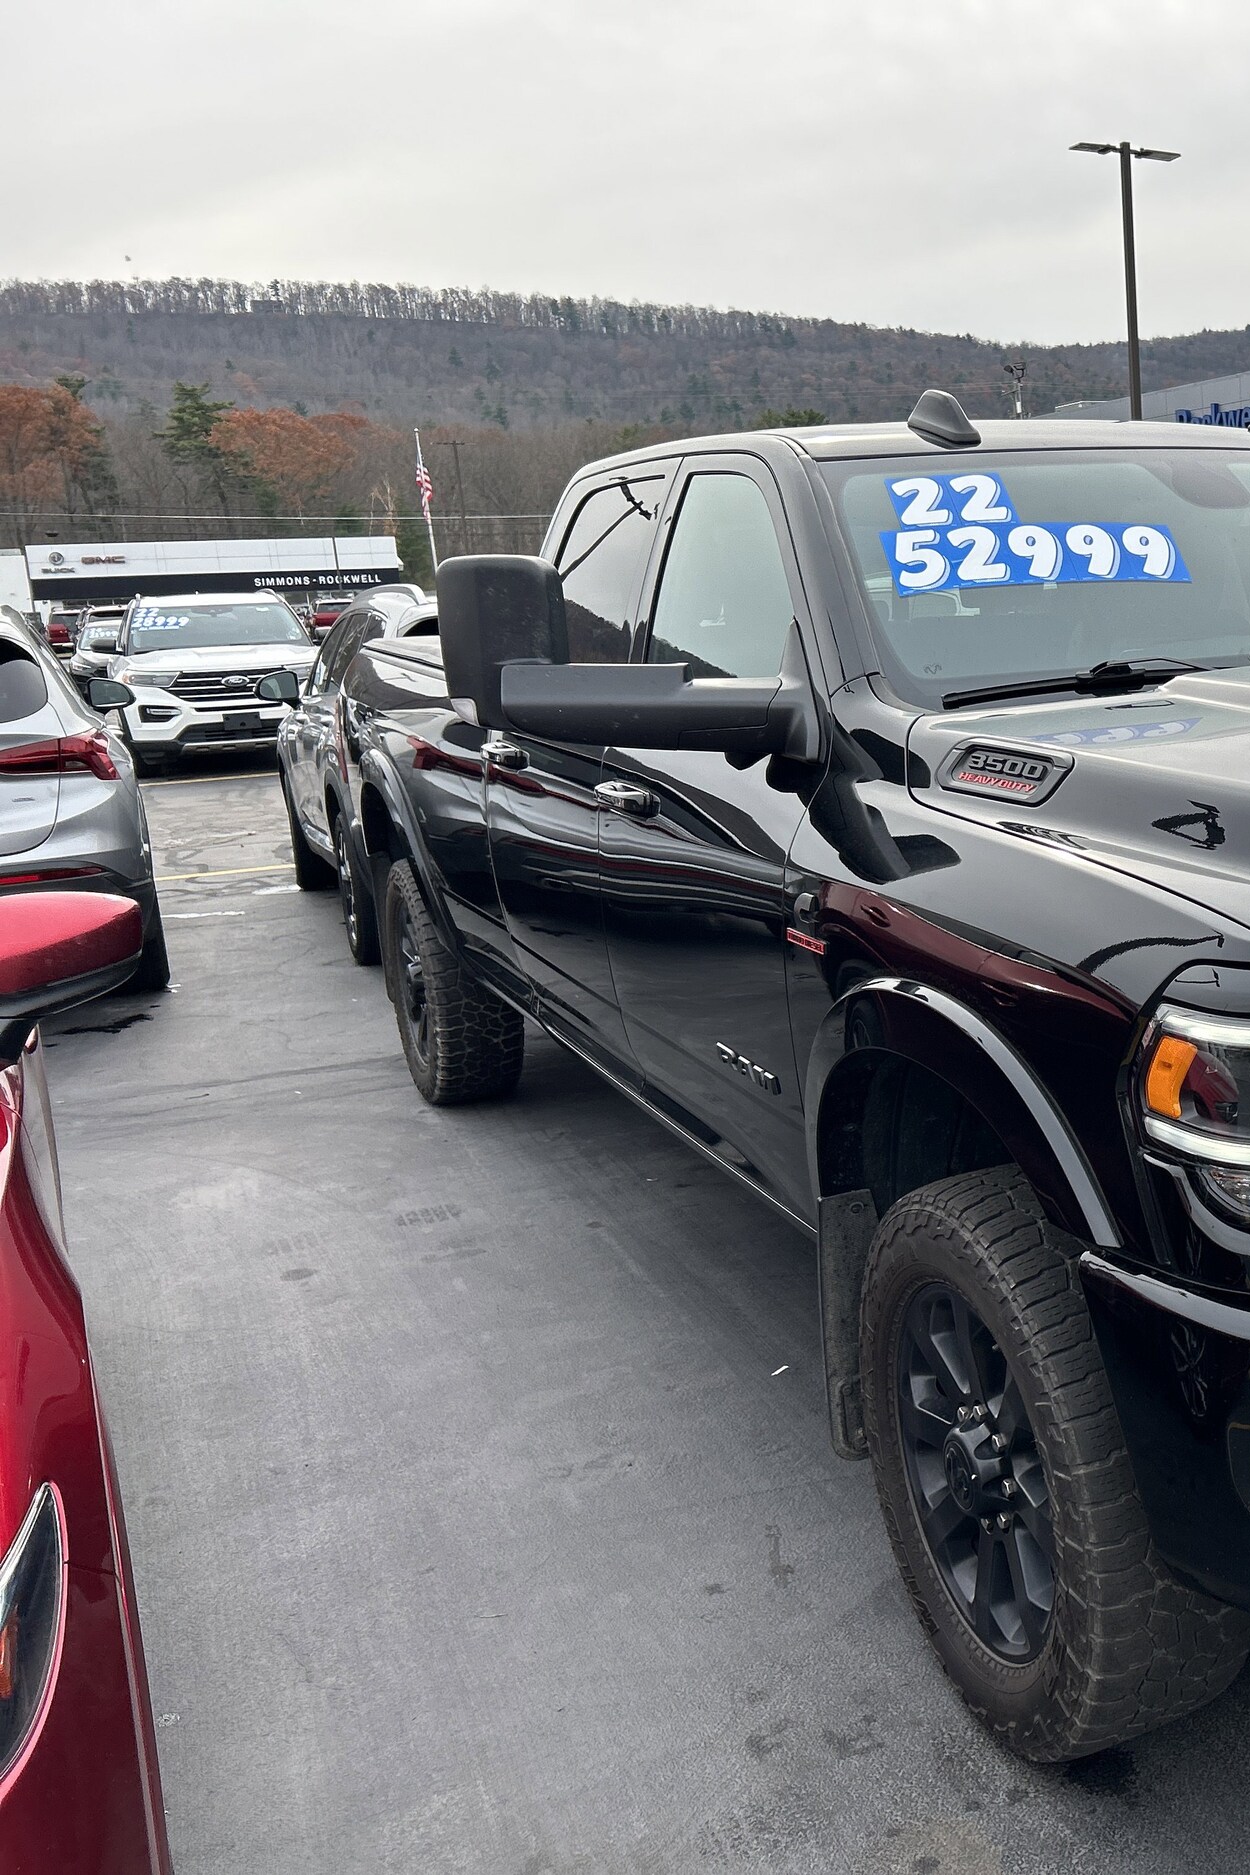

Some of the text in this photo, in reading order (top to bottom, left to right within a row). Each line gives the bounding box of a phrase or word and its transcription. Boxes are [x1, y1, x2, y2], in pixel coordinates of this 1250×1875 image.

[891, 474, 1013, 527] 22
[81, 555, 126, 565] GMC
[895, 523, 1176, 591] 52999
[131, 616, 190, 628] 28999
[134, 607, 160, 618] 22
[967, 753, 1048, 782] 3500
[716, 1041, 782, 1096] RAM
